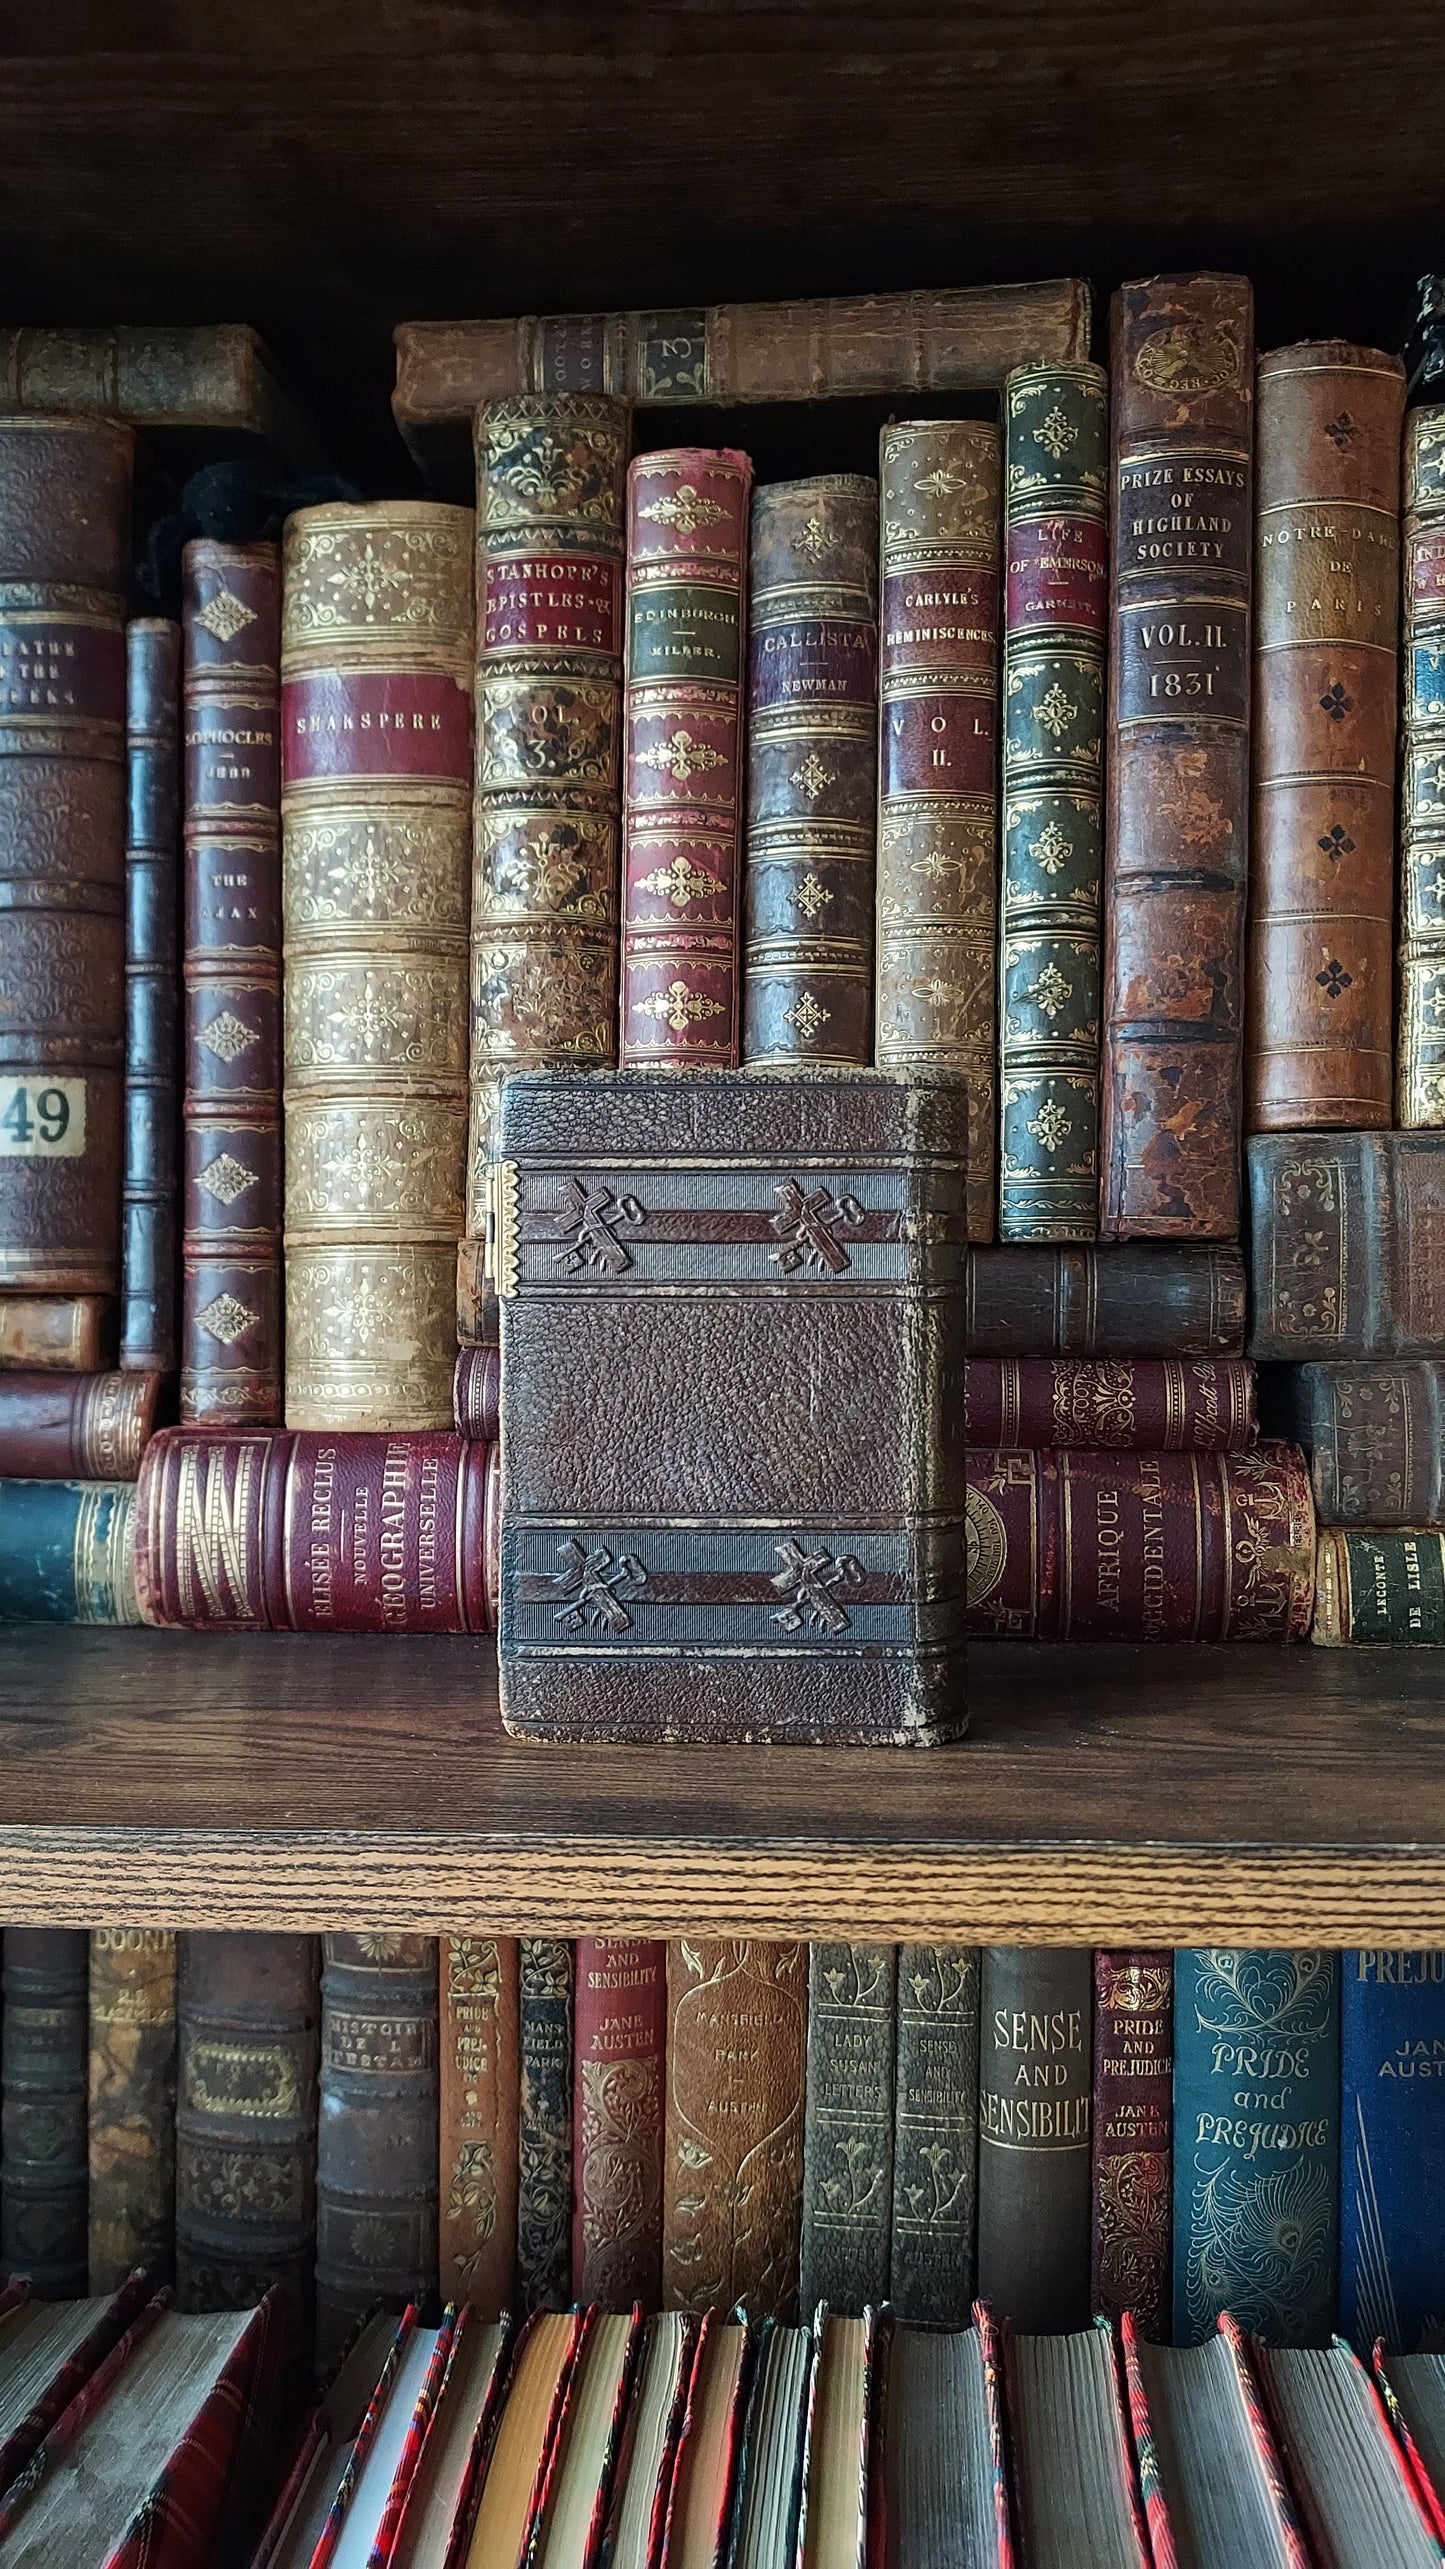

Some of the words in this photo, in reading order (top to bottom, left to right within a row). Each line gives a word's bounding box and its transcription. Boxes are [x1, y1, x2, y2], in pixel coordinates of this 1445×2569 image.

[660, 336, 692, 359] 2
[1120, 468, 1174, 491] PRIZE
[1182, 467, 1245, 488] ESSAYS
[1170, 492, 1195, 509] OF
[1038, 528, 1084, 544] LIFE
[1132, 515, 1232, 537] HIGHLAND
[1137, 541, 1224, 561] SOCIETY
[485, 563, 609, 587] STANHOPE'S
[1009, 559, 1030, 574] OF
[1329, 560, 1352, 574] DE
[905, 586, 979, 608] CARLYLE'S
[1285, 597, 1382, 617] PARIS
[485, 622, 603, 645] GOSPELS
[764, 631, 867, 654] CALLISTA
[781, 677, 848, 695] NEWMAN
[1149, 672, 1214, 697] 1831
[296, 711, 442, 735] SHAKSPERE
[890, 715, 990, 738] VOL.
[185, 729, 273, 747] SOPHOCLES
[931, 749, 953, 767] II.
[212, 873, 248, 888] THE
[201, 906, 258, 920] AJAX
[1, 1086, 70, 1143] 49
[311, 1448, 337, 1533] RECLUS
[353, 1485, 369, 1587] NOUVELLE
[418, 1457, 439, 1611] UNIVERSELLE
[1096, 1490, 1125, 1614] AFRIQUE
[1404, 1541, 1421, 1591] LISLE
[1373, 1555, 1388, 1616] LECONTE
[1409, 1606, 1422, 1629] DE
[606, 1953, 639, 1968] AND
[587, 1966, 657, 1989] SENSIBILITY
[456, 2005, 490, 2021] PRIDE
[599, 2014, 643, 2031] JANE
[993, 2008, 1083, 2054] SENSE
[1113, 2019, 1165, 2036] PRIDE
[522, 2036, 563, 2050] FIELD
[590, 2028, 655, 2050] AUSTEN
[834, 2033, 873, 2048] LADY
[1123, 2040, 1155, 2055] AND
[455, 2056, 488, 2073] UDICE
[524, 2053, 563, 2069] PARK
[715, 2048, 760, 2061] PARK
[1210, 2042, 1310, 2079] PRIDE
[829, 2058, 879, 2074] SUSAN
[925, 2065, 951, 2079] AND
[1014, 2064, 1068, 2087] AND
[1103, 2056, 1172, 2077] PREJUDICE
[824, 2082, 883, 2100] LETTERS
[908, 2087, 966, 2104] SENSIBILITY
[1234, 2085, 1293, 2110] and
[1115, 2104, 1160, 2119] JANE
[1106, 2120, 1168, 2138] AUSTEN
[1195, 2112, 1330, 2162] PREJUDICE
